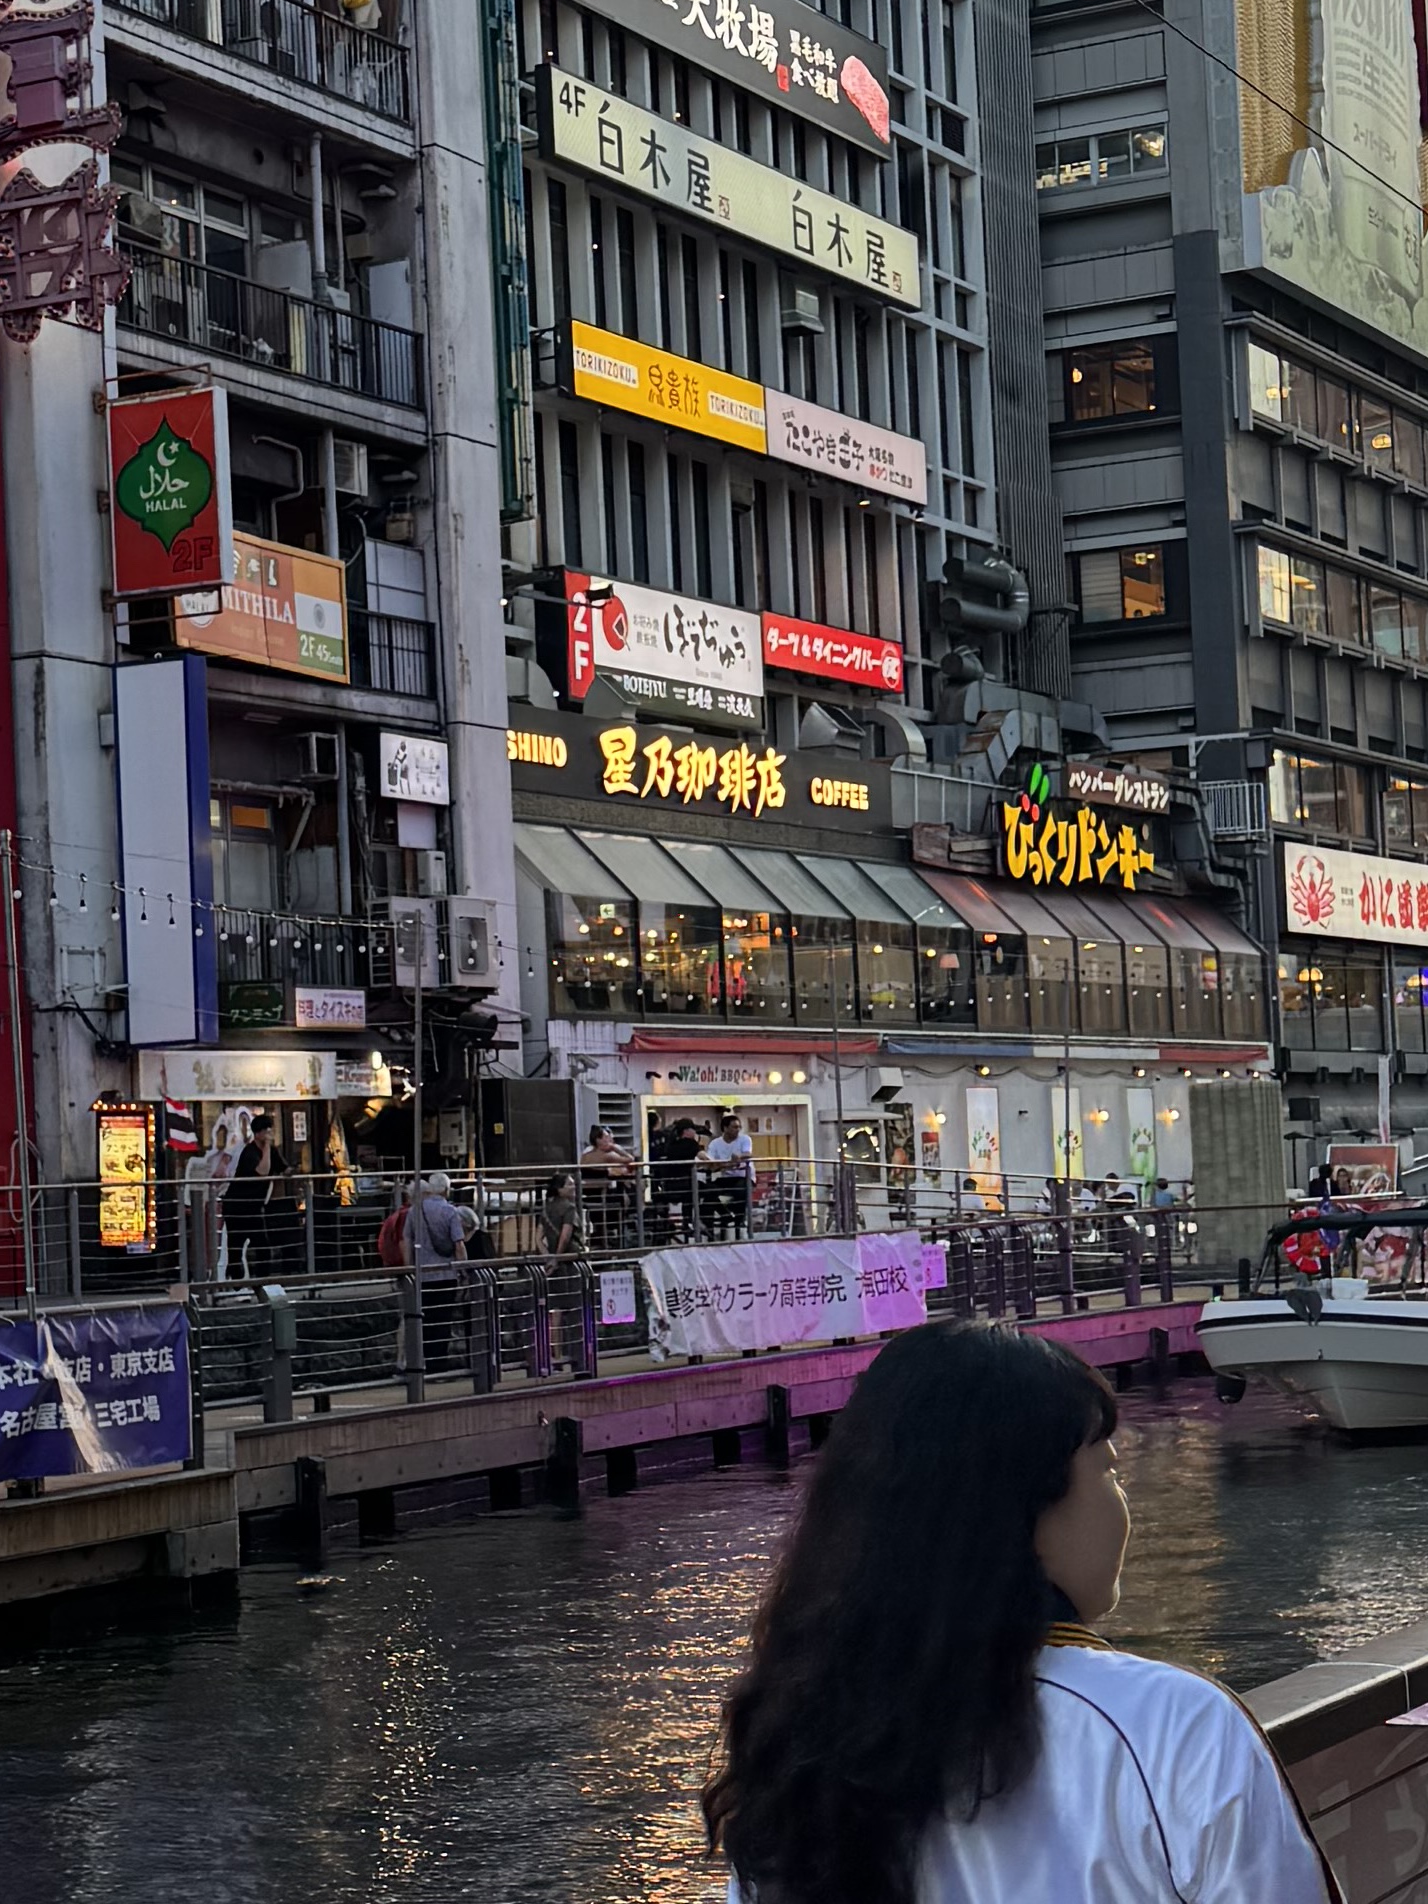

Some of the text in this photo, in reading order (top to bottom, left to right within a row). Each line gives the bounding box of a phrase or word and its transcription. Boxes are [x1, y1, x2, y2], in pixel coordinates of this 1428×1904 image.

[558, 80, 587, 120] 4F
[597, 99, 890, 289] 白木屋 白木屋
[647, 363, 702, 419] 鳥貴族
[138, 464, 190, 500] حلال
[144, 497, 187, 514] HALAL
[172, 538, 213, 574] 2F
[220, 584, 295, 626] MITHILA
[299, 634, 315, 657] 2F
[598, 725, 787, 819] 星乃珈琲店
[1069, 768, 1171, 810] ハンバーグレストラン
[810, 777, 870, 811] COFFEE
[1003, 800, 1156, 892] びっくりドンキー
